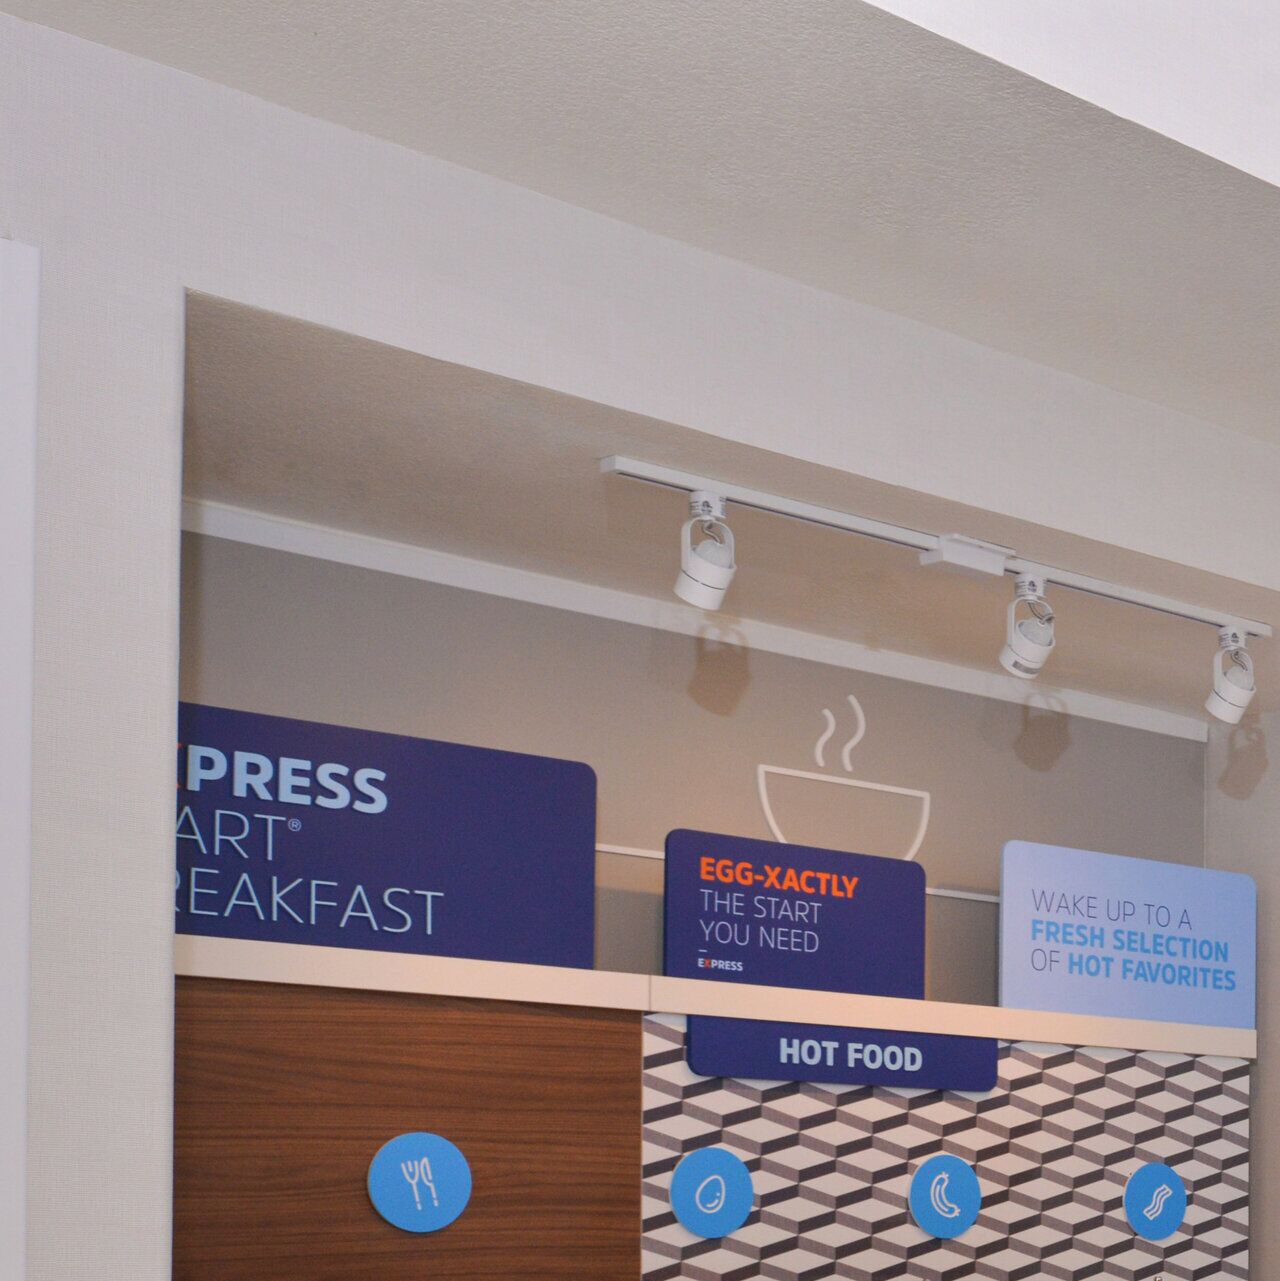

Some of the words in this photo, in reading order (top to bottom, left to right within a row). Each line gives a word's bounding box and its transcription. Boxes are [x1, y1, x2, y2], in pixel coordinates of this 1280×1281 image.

[177, 743, 388, 814] PRESS
[700, 856, 859, 899] EGG-XACTLY
[700, 888, 745, 916] THE
[753, 896, 822, 924] START
[1031, 888, 1098, 919] WAKE
[1106, 899, 1136, 922] UP
[1144, 903, 1171, 927] TO
[1178, 909, 1192, 930] A
[699, 919, 750, 946] YOU
[759, 926, 820, 953] NEED
[1031, 919, 1105, 948] FRESH
[1113, 928, 1229, 963] SELECTION
[697, 958, 743, 971] EXPRESS
[1031, 948, 1060, 972] OF
[1068, 953, 1114, 978] HOT
[1121, 958, 1237, 991] FAVORITES
[779, 1037, 840, 1067] HOT
[847, 1042, 923, 1072] FOOD
